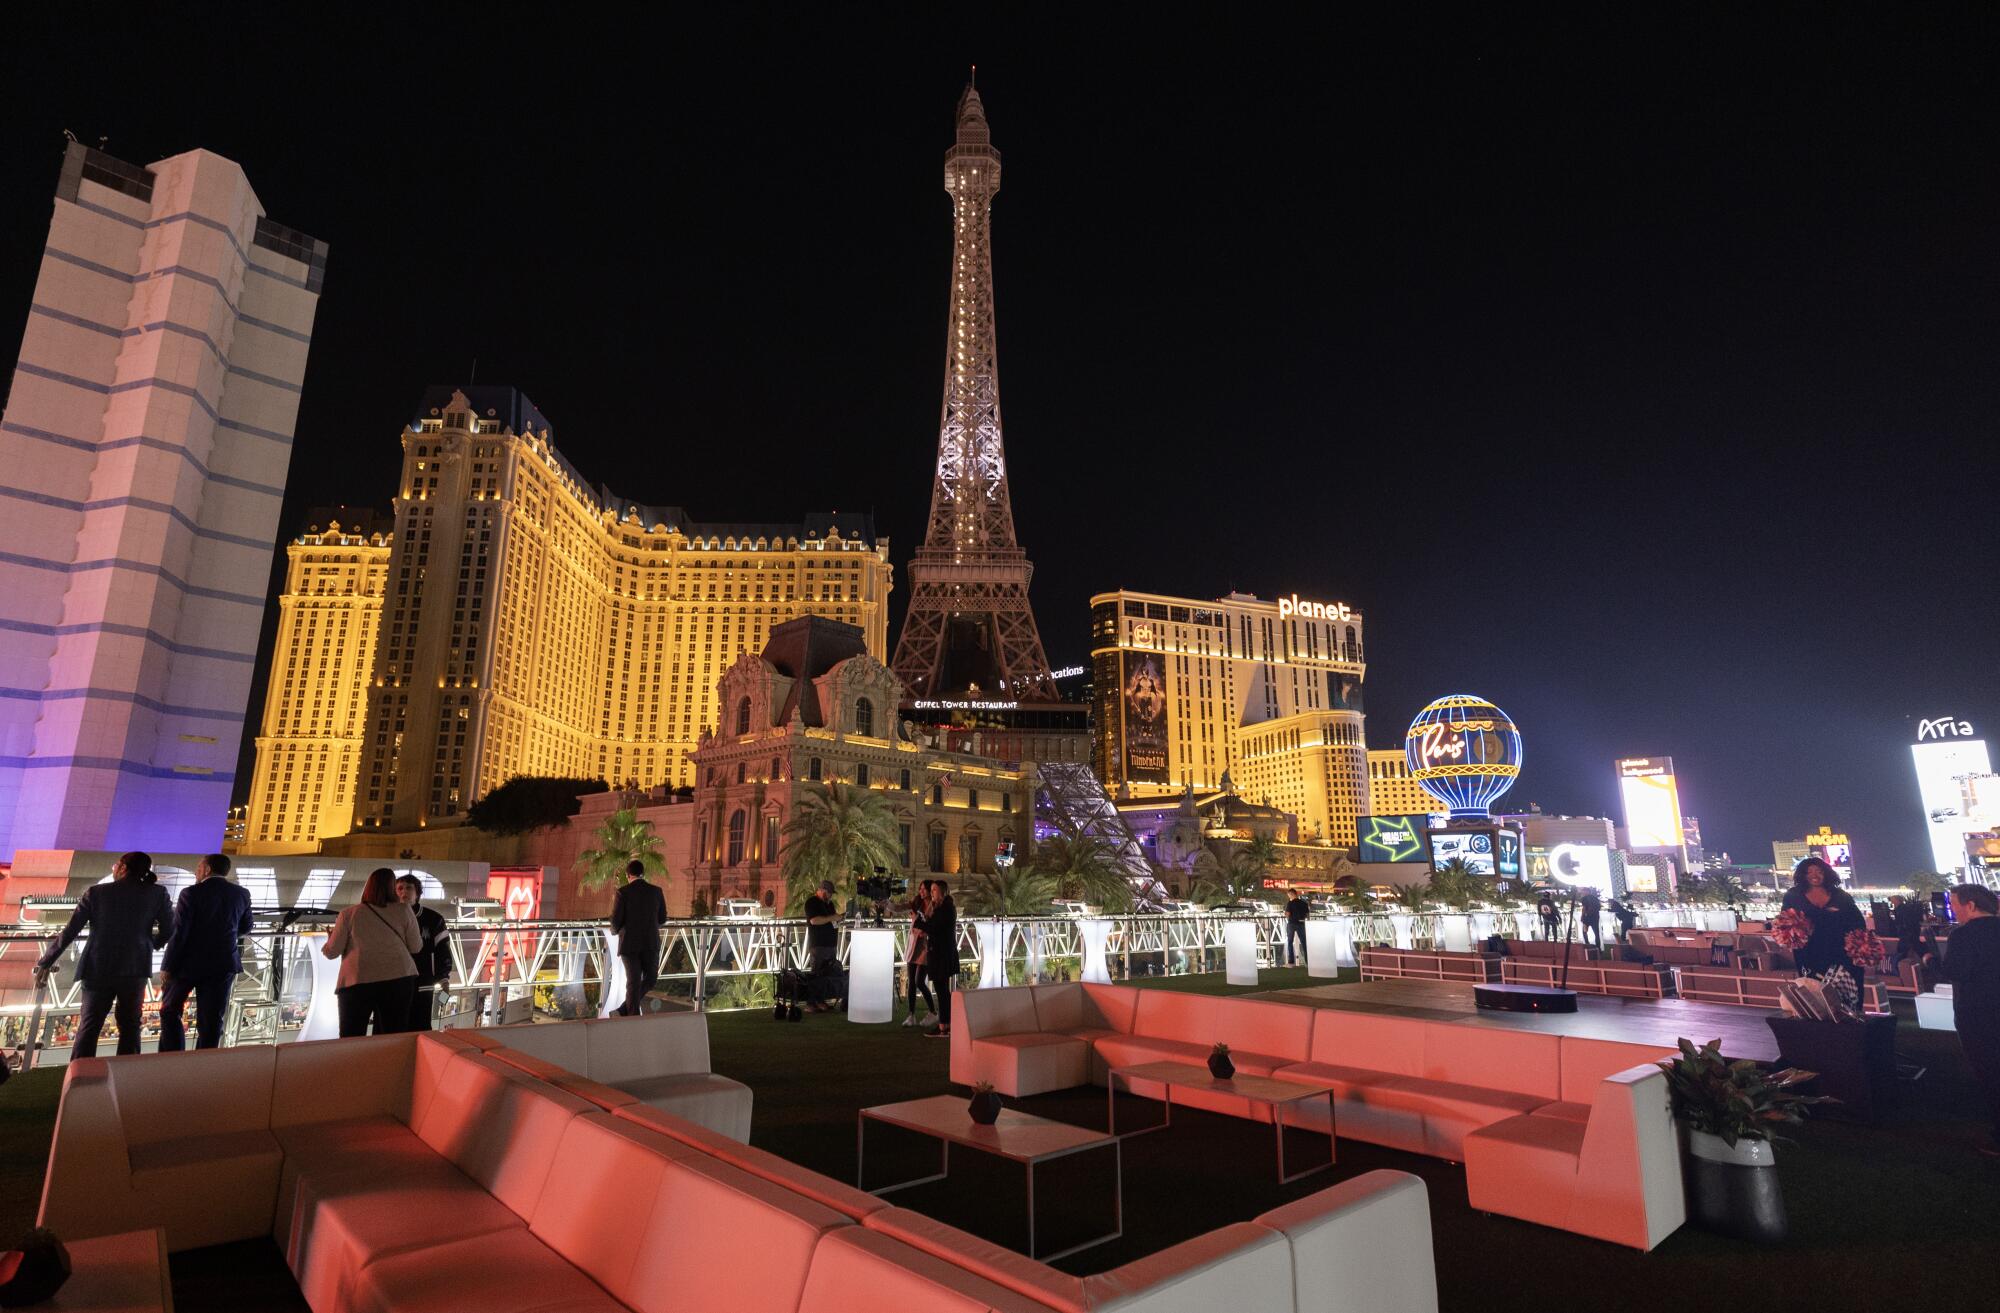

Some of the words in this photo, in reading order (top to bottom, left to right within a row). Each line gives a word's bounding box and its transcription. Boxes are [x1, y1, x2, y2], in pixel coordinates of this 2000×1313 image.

[1279, 595, 1350, 621] planet
[1050, 666, 1084, 679] acations
[914, 700, 940, 709] EIFFEL
[941, 700, 968, 709] TOWER
[971, 700, 1017, 709] RESTAURANT
[1918, 717, 1973, 740] Aria
[1423, 723, 1465, 771] Paris
[1807, 835, 1848, 845] MGM
